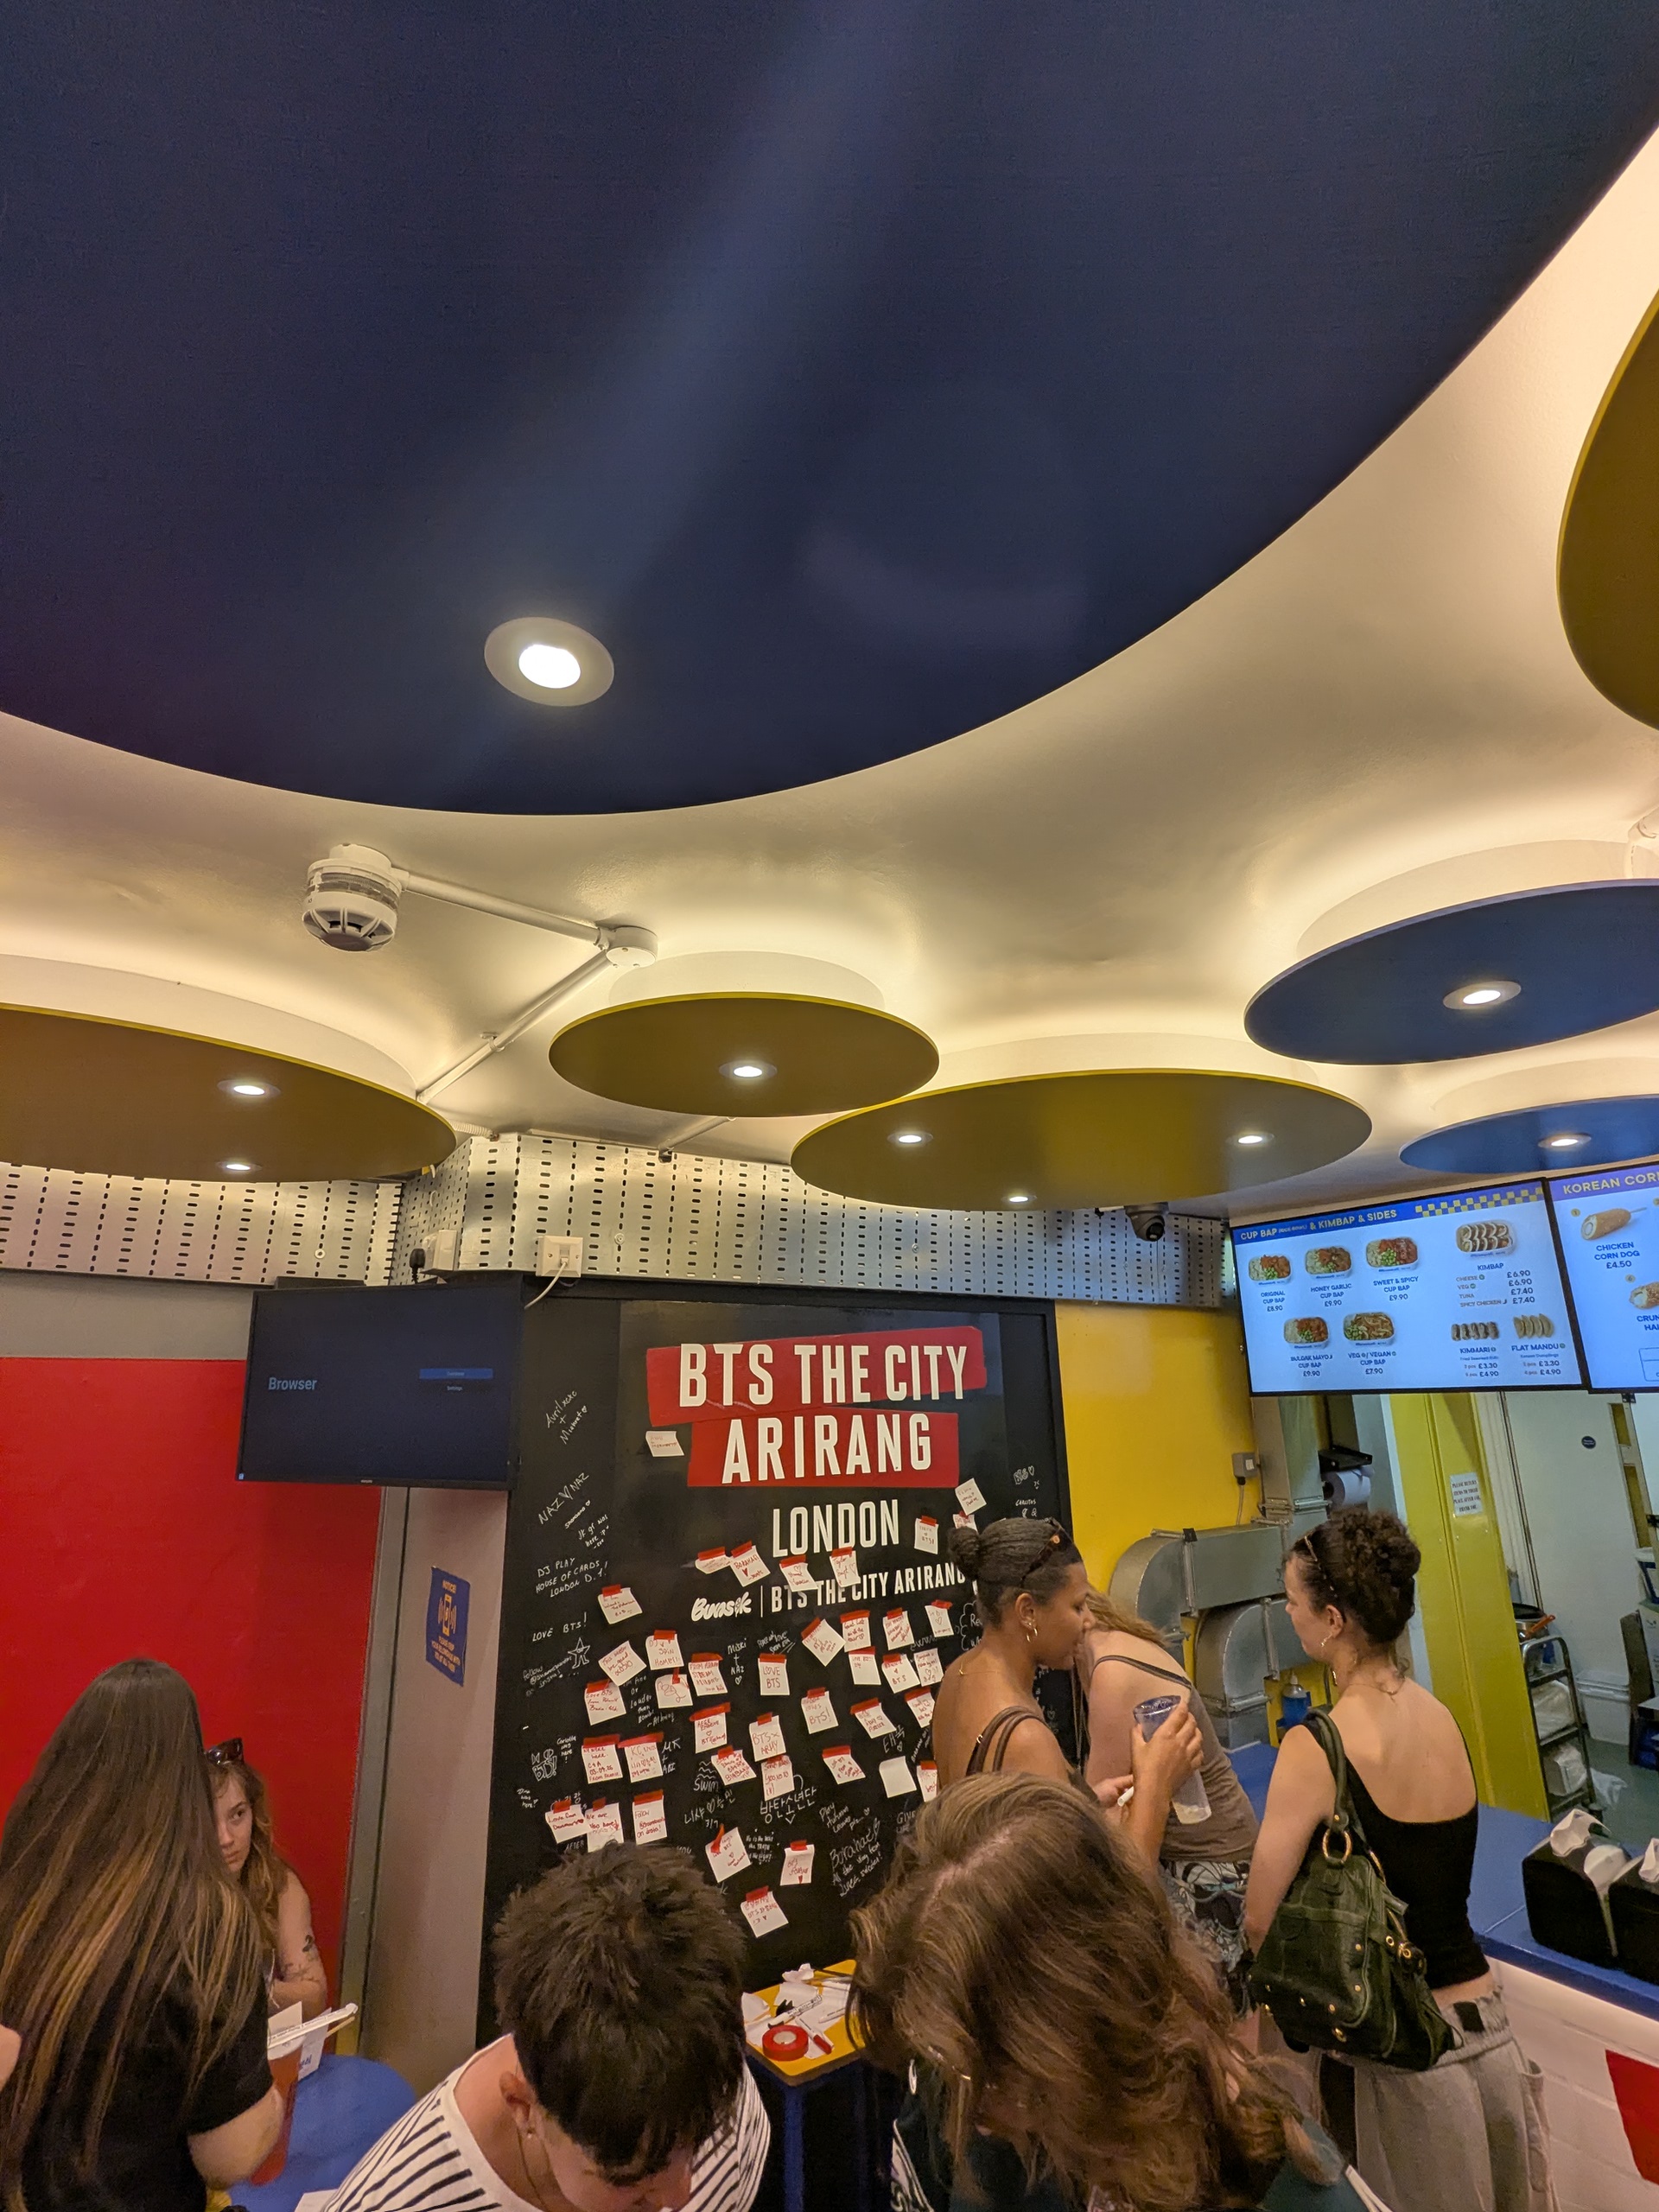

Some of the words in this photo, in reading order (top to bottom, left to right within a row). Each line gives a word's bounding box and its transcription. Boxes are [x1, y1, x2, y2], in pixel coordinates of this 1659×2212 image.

[1563, 1178, 1620, 1194] KOREAN
[1241, 1231, 1258, 1240] CUP
[1260, 1228, 1277, 1238] BAP
[1319, 1217, 1355, 1229] KIMBAP
[1367, 1210, 1397, 1221] SIDES
[1596, 1242, 1634, 1251] CHICKEN
[1478, 1262, 1503, 1271] KIMBAP
[1606, 1260, 1631, 1268] £4.50
[1507, 1269, 1530, 1278] £6.90
[1509, 1278, 1532, 1287] £6.90
[268, 1376, 317, 1390] Browser
[679, 1343, 773, 1408] BTS
[794, 1344, 871, 1404] THE
[885, 1344, 967, 1402] CITY
[721, 1413, 931, 1484] ARIRANG
[538, 1497, 564, 1524] NAZ
[570, 1472, 589, 1491] NAZ
[772, 1499, 899, 1558] LONDON
[536, 1577, 557, 1593] HOUSE
[561, 1570, 572, 1581] OF
[574, 1560, 601, 1575] CARDS
[537, 1566, 550, 1578] DJ
[556, 1558, 575, 1570] PLAY
[550, 1580, 580, 1598] LONDON
[772, 1586, 808, 1613] BTS
[817, 1579, 846, 1606] THE
[851, 1572, 888, 1601] CITY
[532, 1628, 553, 1642] LOVE
[563, 1611, 587, 1633] BTS!
[763, 1666, 780, 1675] LOVE
[766, 1677, 781, 1688] BTS
[809, 1707, 831, 1725] BTS!
[753, 1732, 771, 1745] BTS
[760, 1740, 779, 1754] ARMY
